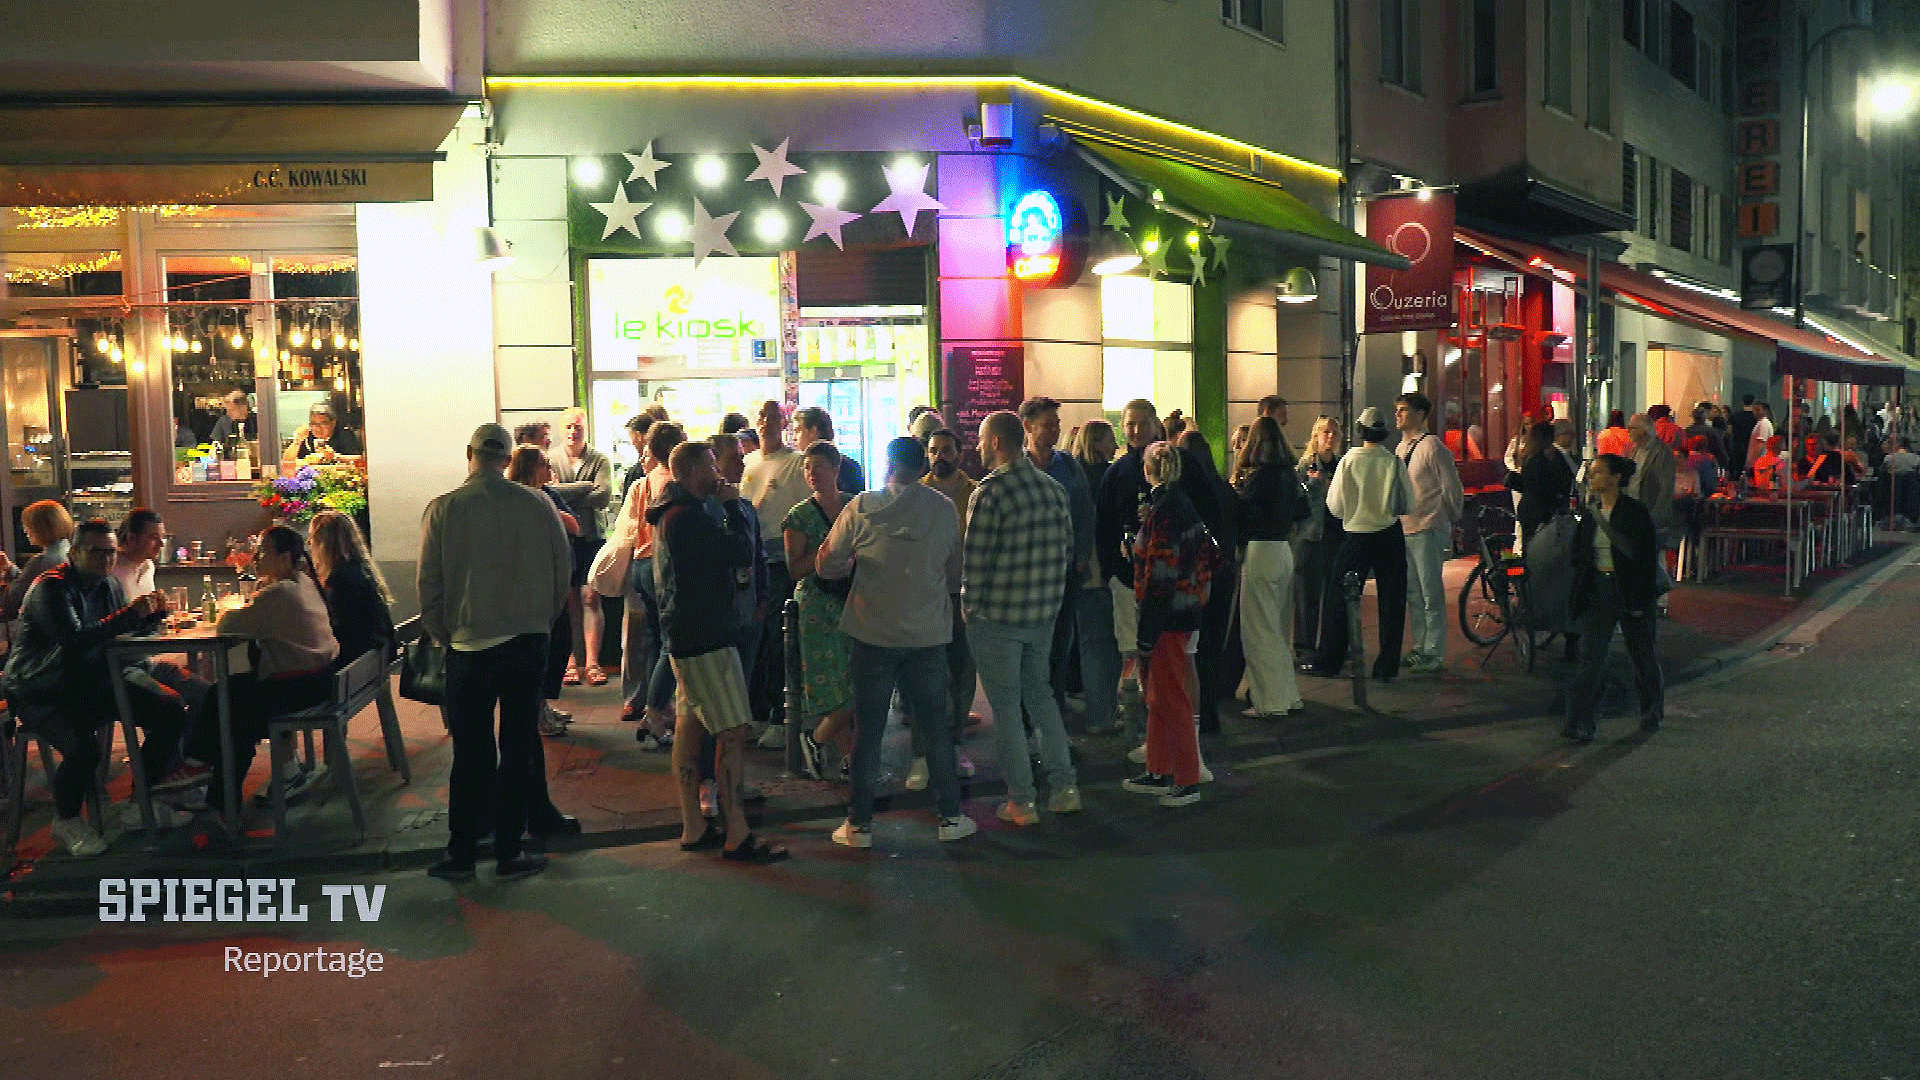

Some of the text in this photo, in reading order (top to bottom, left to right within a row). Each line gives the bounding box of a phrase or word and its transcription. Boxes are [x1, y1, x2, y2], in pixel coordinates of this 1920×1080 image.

[253, 168, 367, 188] C.C. KOWALSKI
[1370, 284, 1447, 310] Ouzeria
[615, 309, 760, 339] le kiosk
